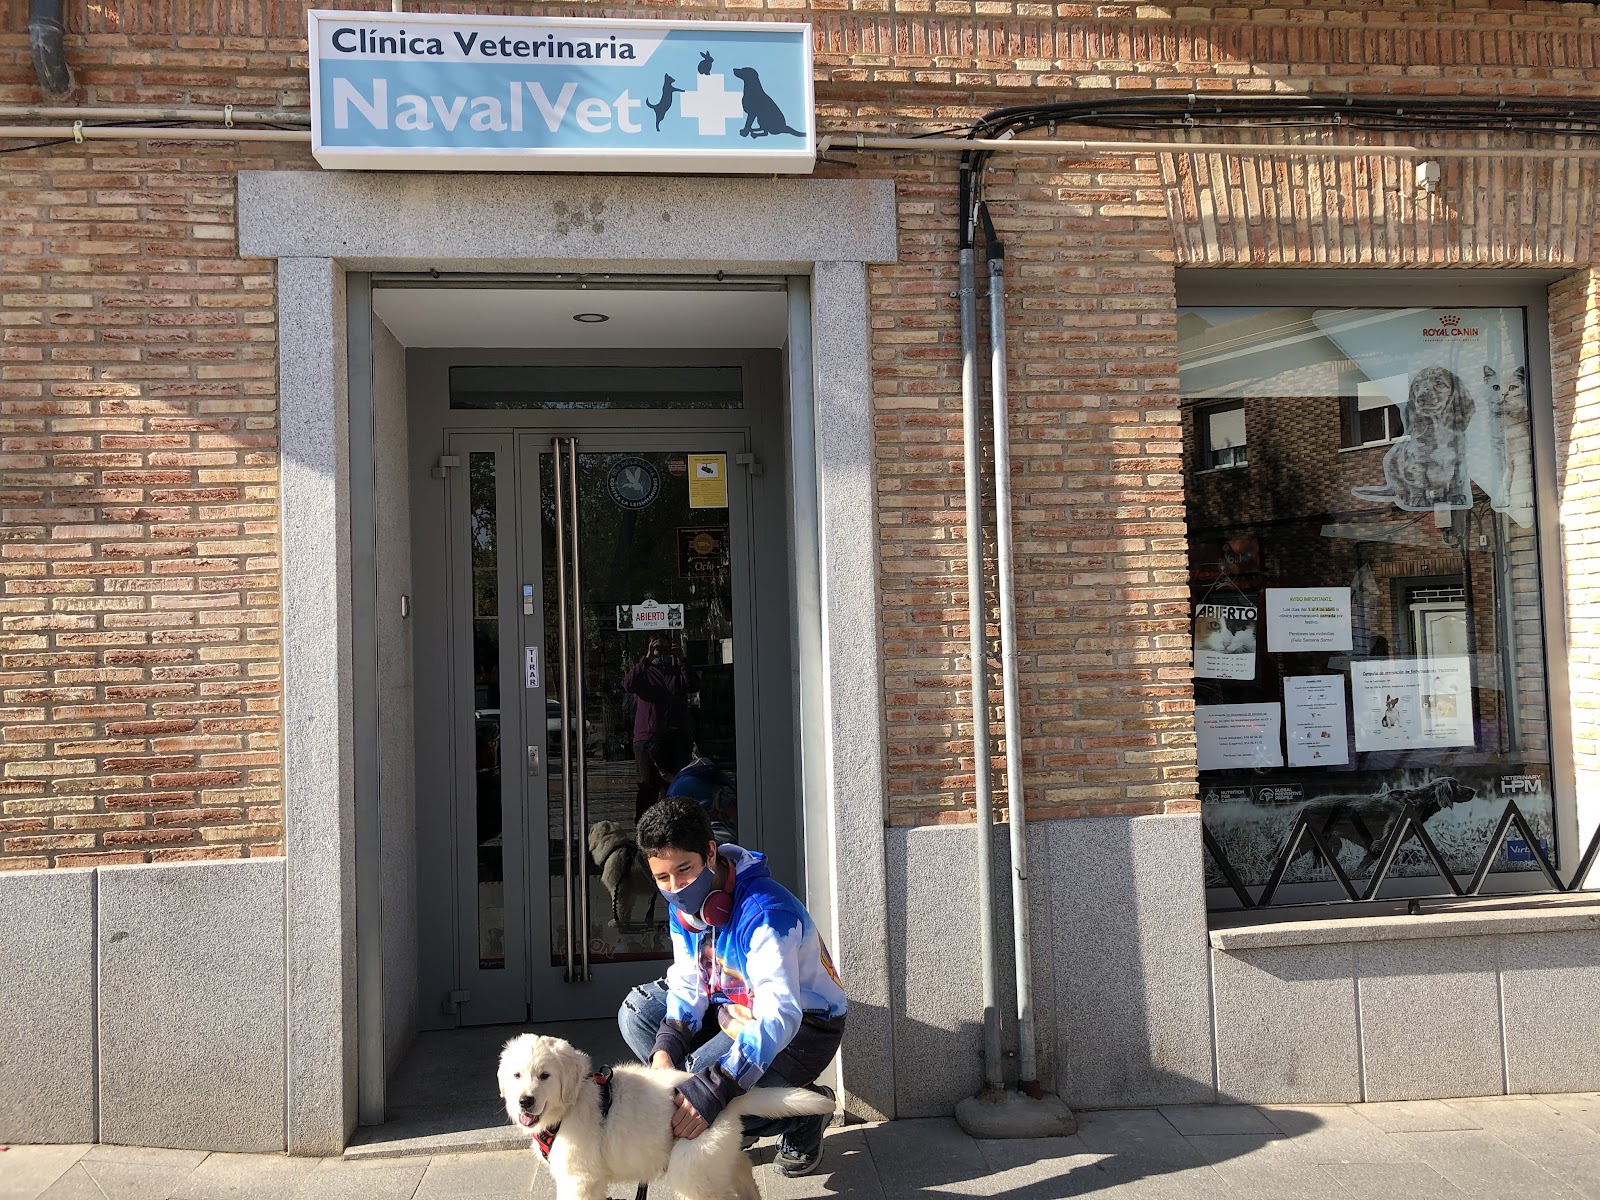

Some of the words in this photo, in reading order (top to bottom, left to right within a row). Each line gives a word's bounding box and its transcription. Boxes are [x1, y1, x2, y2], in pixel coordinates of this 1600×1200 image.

[331, 27, 445, 56] Clínica
[453, 31, 636, 61] Veterinaria
[332, 76, 642, 135] NavalVet
[1422, 328, 1450, 337] ROYAL
[1450, 327, 1479, 336] CANIN
[635, 611, 665, 621] ABIERTO
[1196, 605, 1257, 621] ABIERTO
[528, 649, 536, 686] TIRAR
[1500, 780, 1542, 794] HPM
